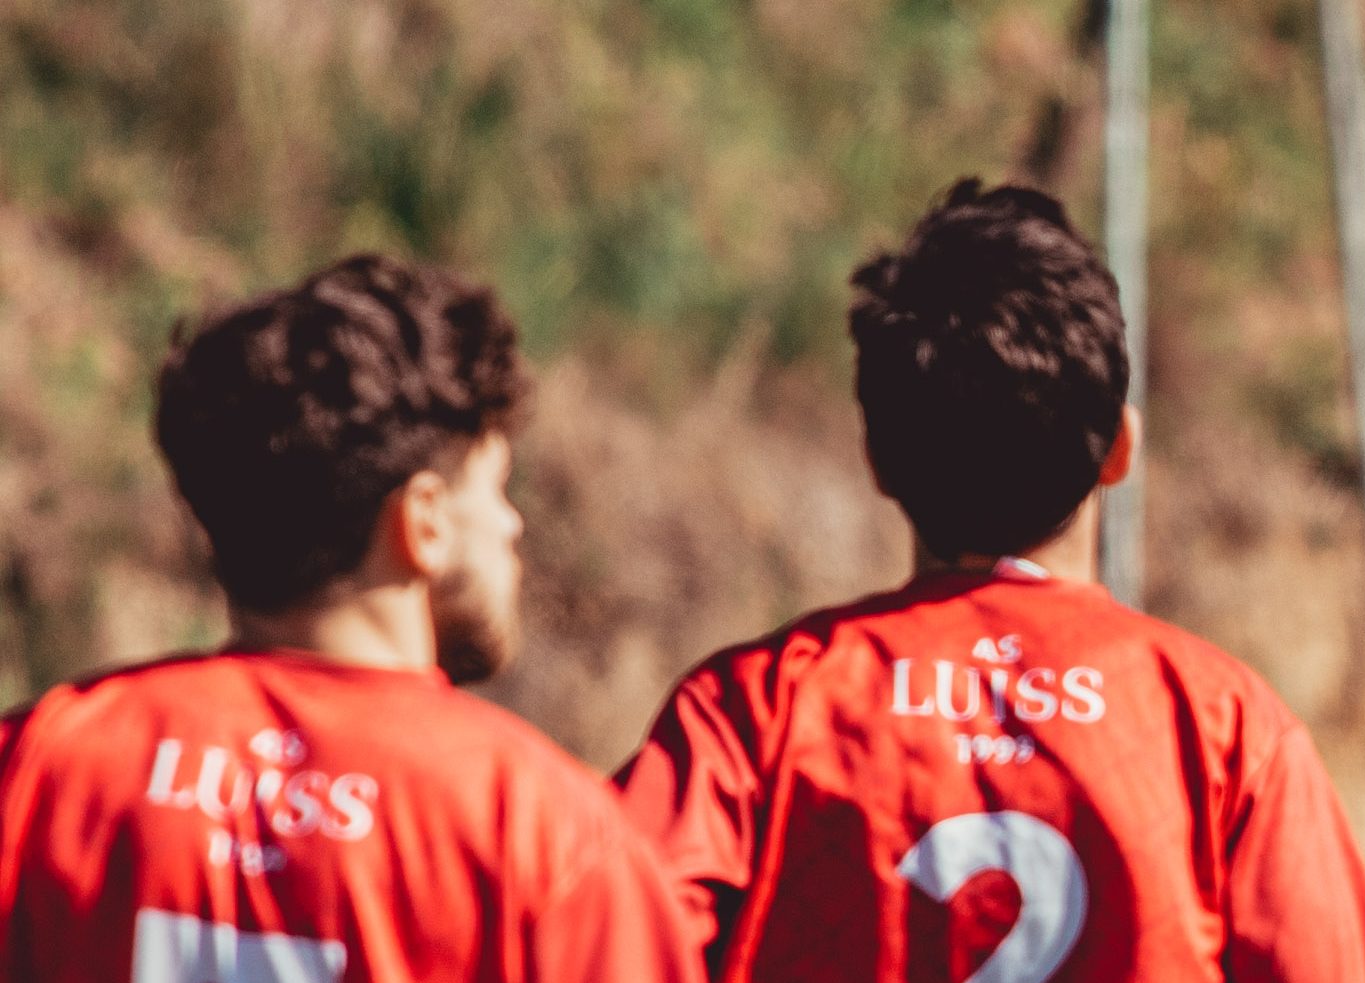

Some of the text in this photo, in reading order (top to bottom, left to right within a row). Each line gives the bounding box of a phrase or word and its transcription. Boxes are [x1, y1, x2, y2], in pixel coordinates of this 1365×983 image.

[971, 633, 1023, 663] AS
[891, 657, 1106, 724] LUISS
[953, 733, 1036, 765] 1999
[146, 738, 380, 842] LUISS
